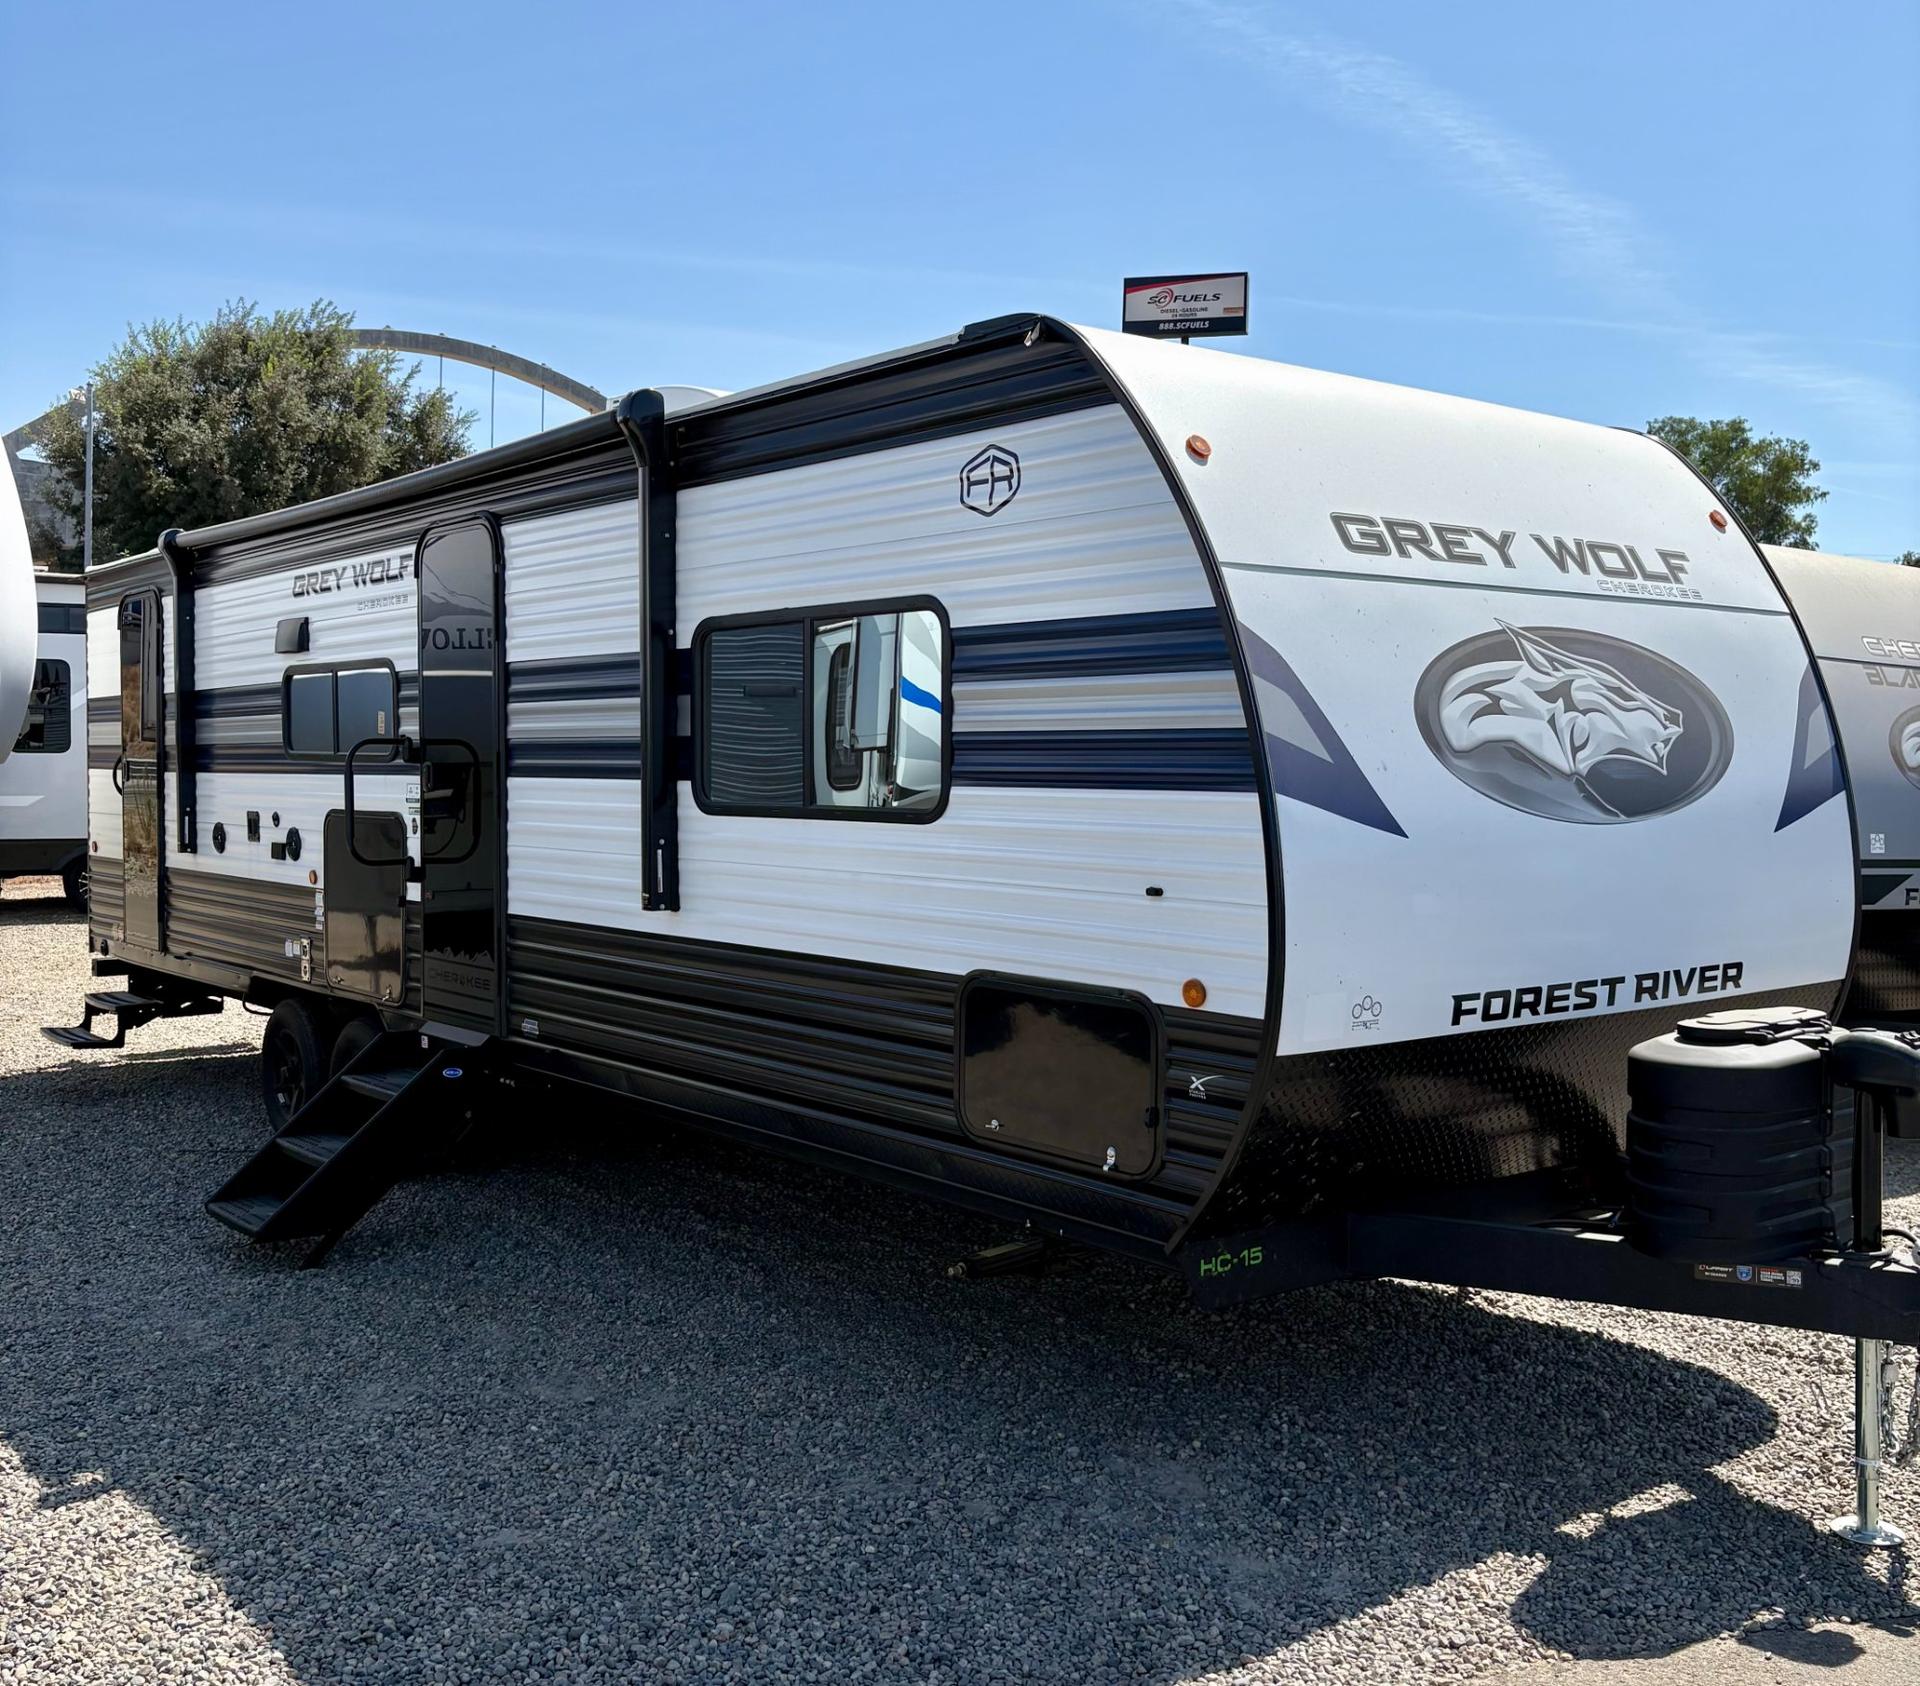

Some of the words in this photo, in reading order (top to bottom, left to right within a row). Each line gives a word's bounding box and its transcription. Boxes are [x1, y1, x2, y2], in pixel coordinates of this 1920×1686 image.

[1173, 293, 1221, 303] FUELS
[1158, 320, 1210, 330] 888.SCFUELS
[1329, 511, 1516, 569] GREY
[1529, 533, 1690, 585] WOLF
[292, 565, 348, 598] GREY
[351, 553, 413, 588] WOLF
[357, 592, 409, 611] CHEROKEE
[1597, 578, 1704, 601] CHEROKEE
[1451, 976, 1625, 1026] FOREST
[1634, 961, 1743, 1003] RIVER
[1200, 1246, 1263, 1277] HC-15
